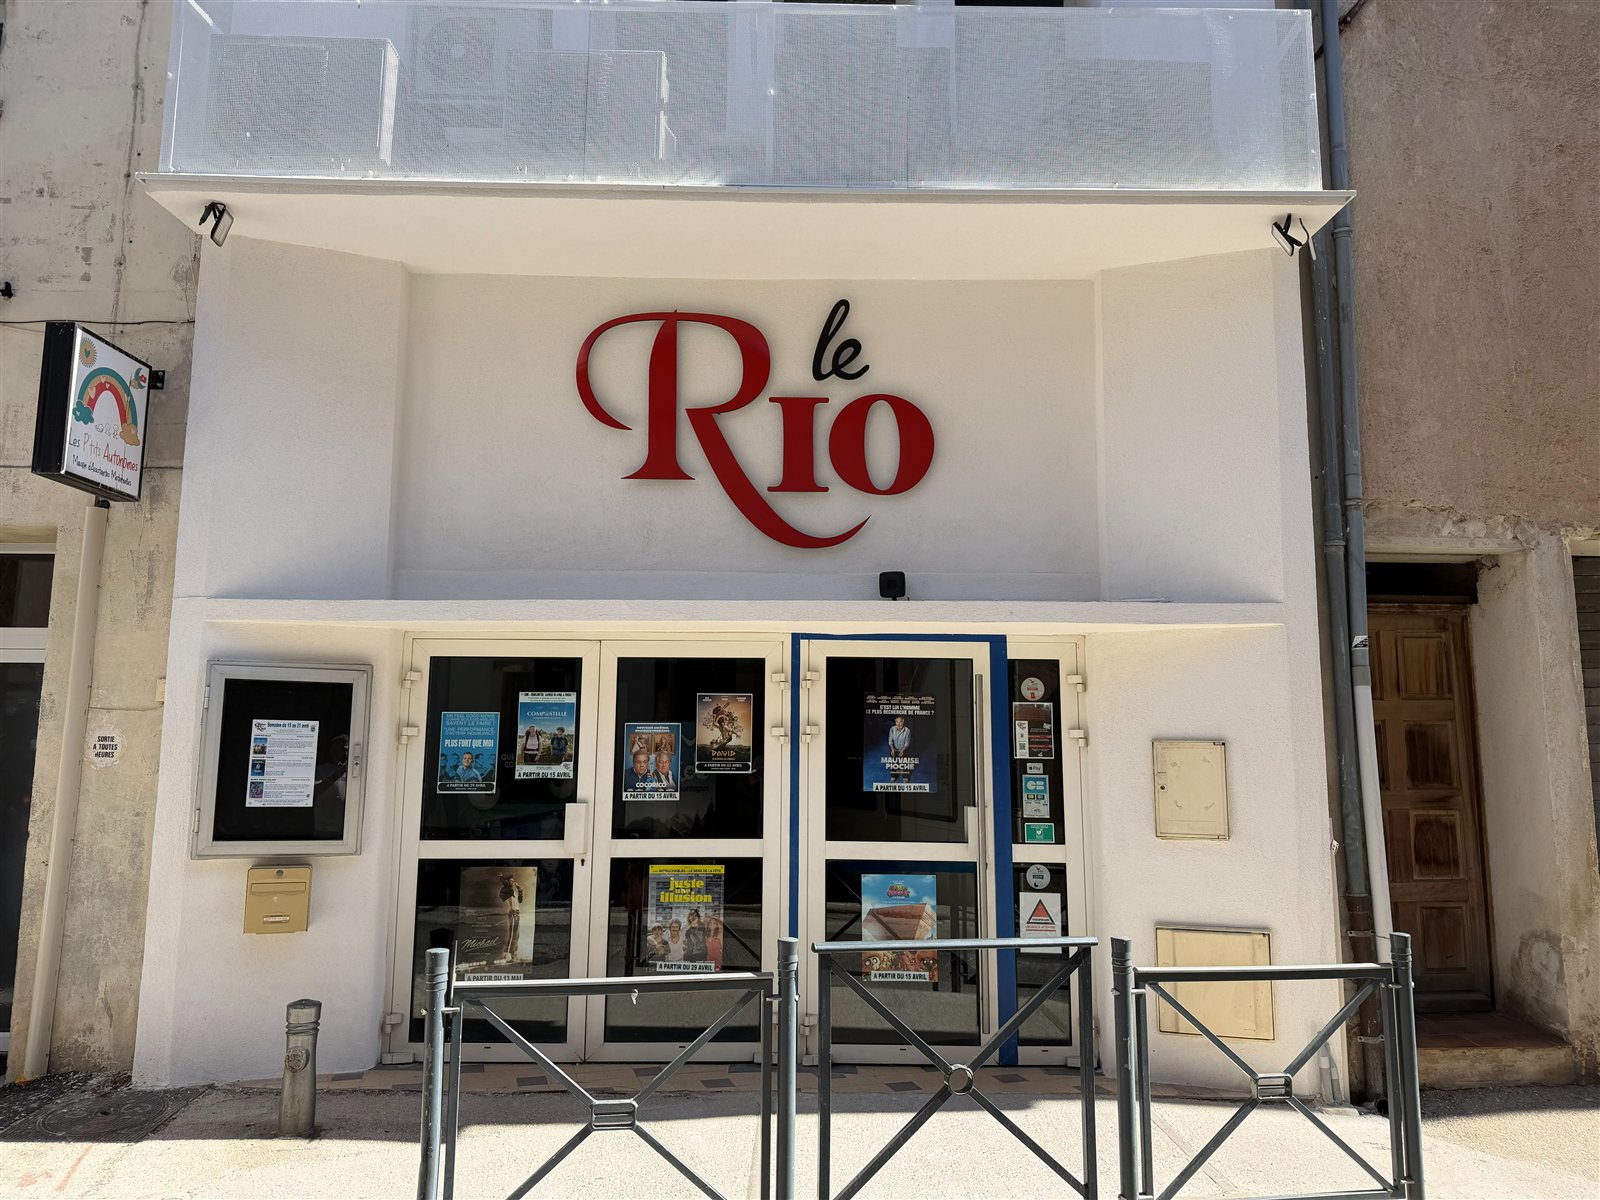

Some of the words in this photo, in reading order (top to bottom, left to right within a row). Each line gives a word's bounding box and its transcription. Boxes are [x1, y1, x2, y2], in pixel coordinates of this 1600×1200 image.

[812, 299, 870, 381] le
[69, 427, 80, 448] Les
[445, 739, 458, 748] PLUS
[459, 739, 471, 748] FORT
[472, 739, 482, 748] QUE
[483, 740, 494, 748] MOI
[669, 877, 704, 890] juste
[660, 892, 712, 903] illusion
[462, 937, 499, 952] Michael
